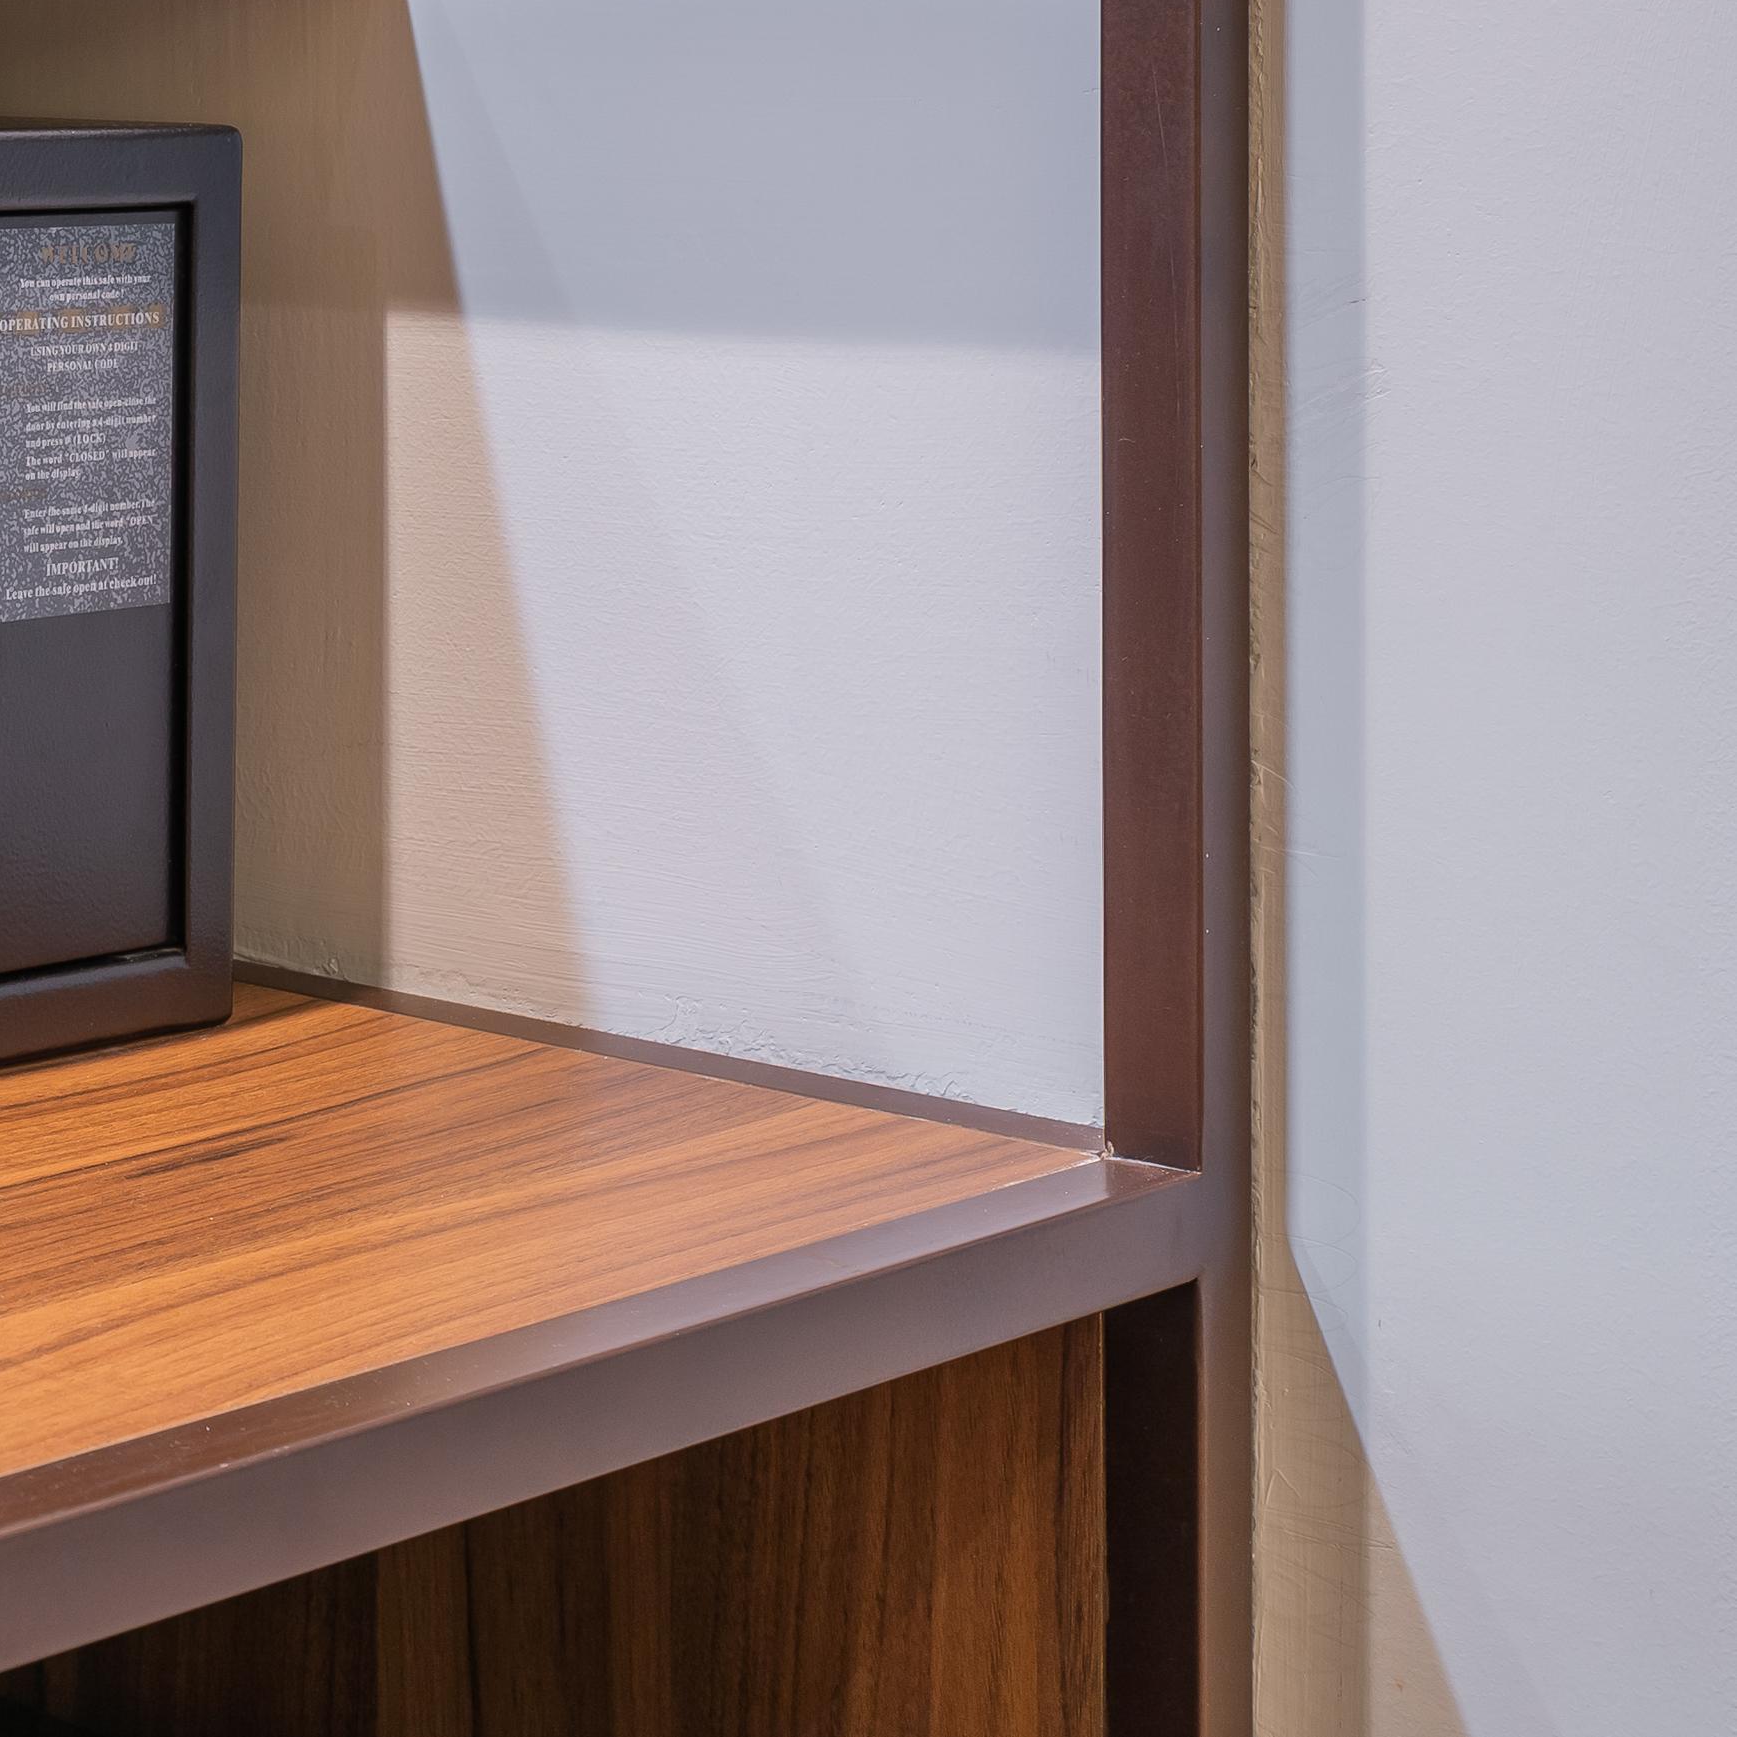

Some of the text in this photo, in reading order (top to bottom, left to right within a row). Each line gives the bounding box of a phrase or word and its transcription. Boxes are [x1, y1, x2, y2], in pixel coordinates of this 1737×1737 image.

[0, 311, 160, 332] OPERATING INSTRUCTIONS
[46, 557, 119, 577] IMPORTANT!
[6, 588, 33, 601] Leave
